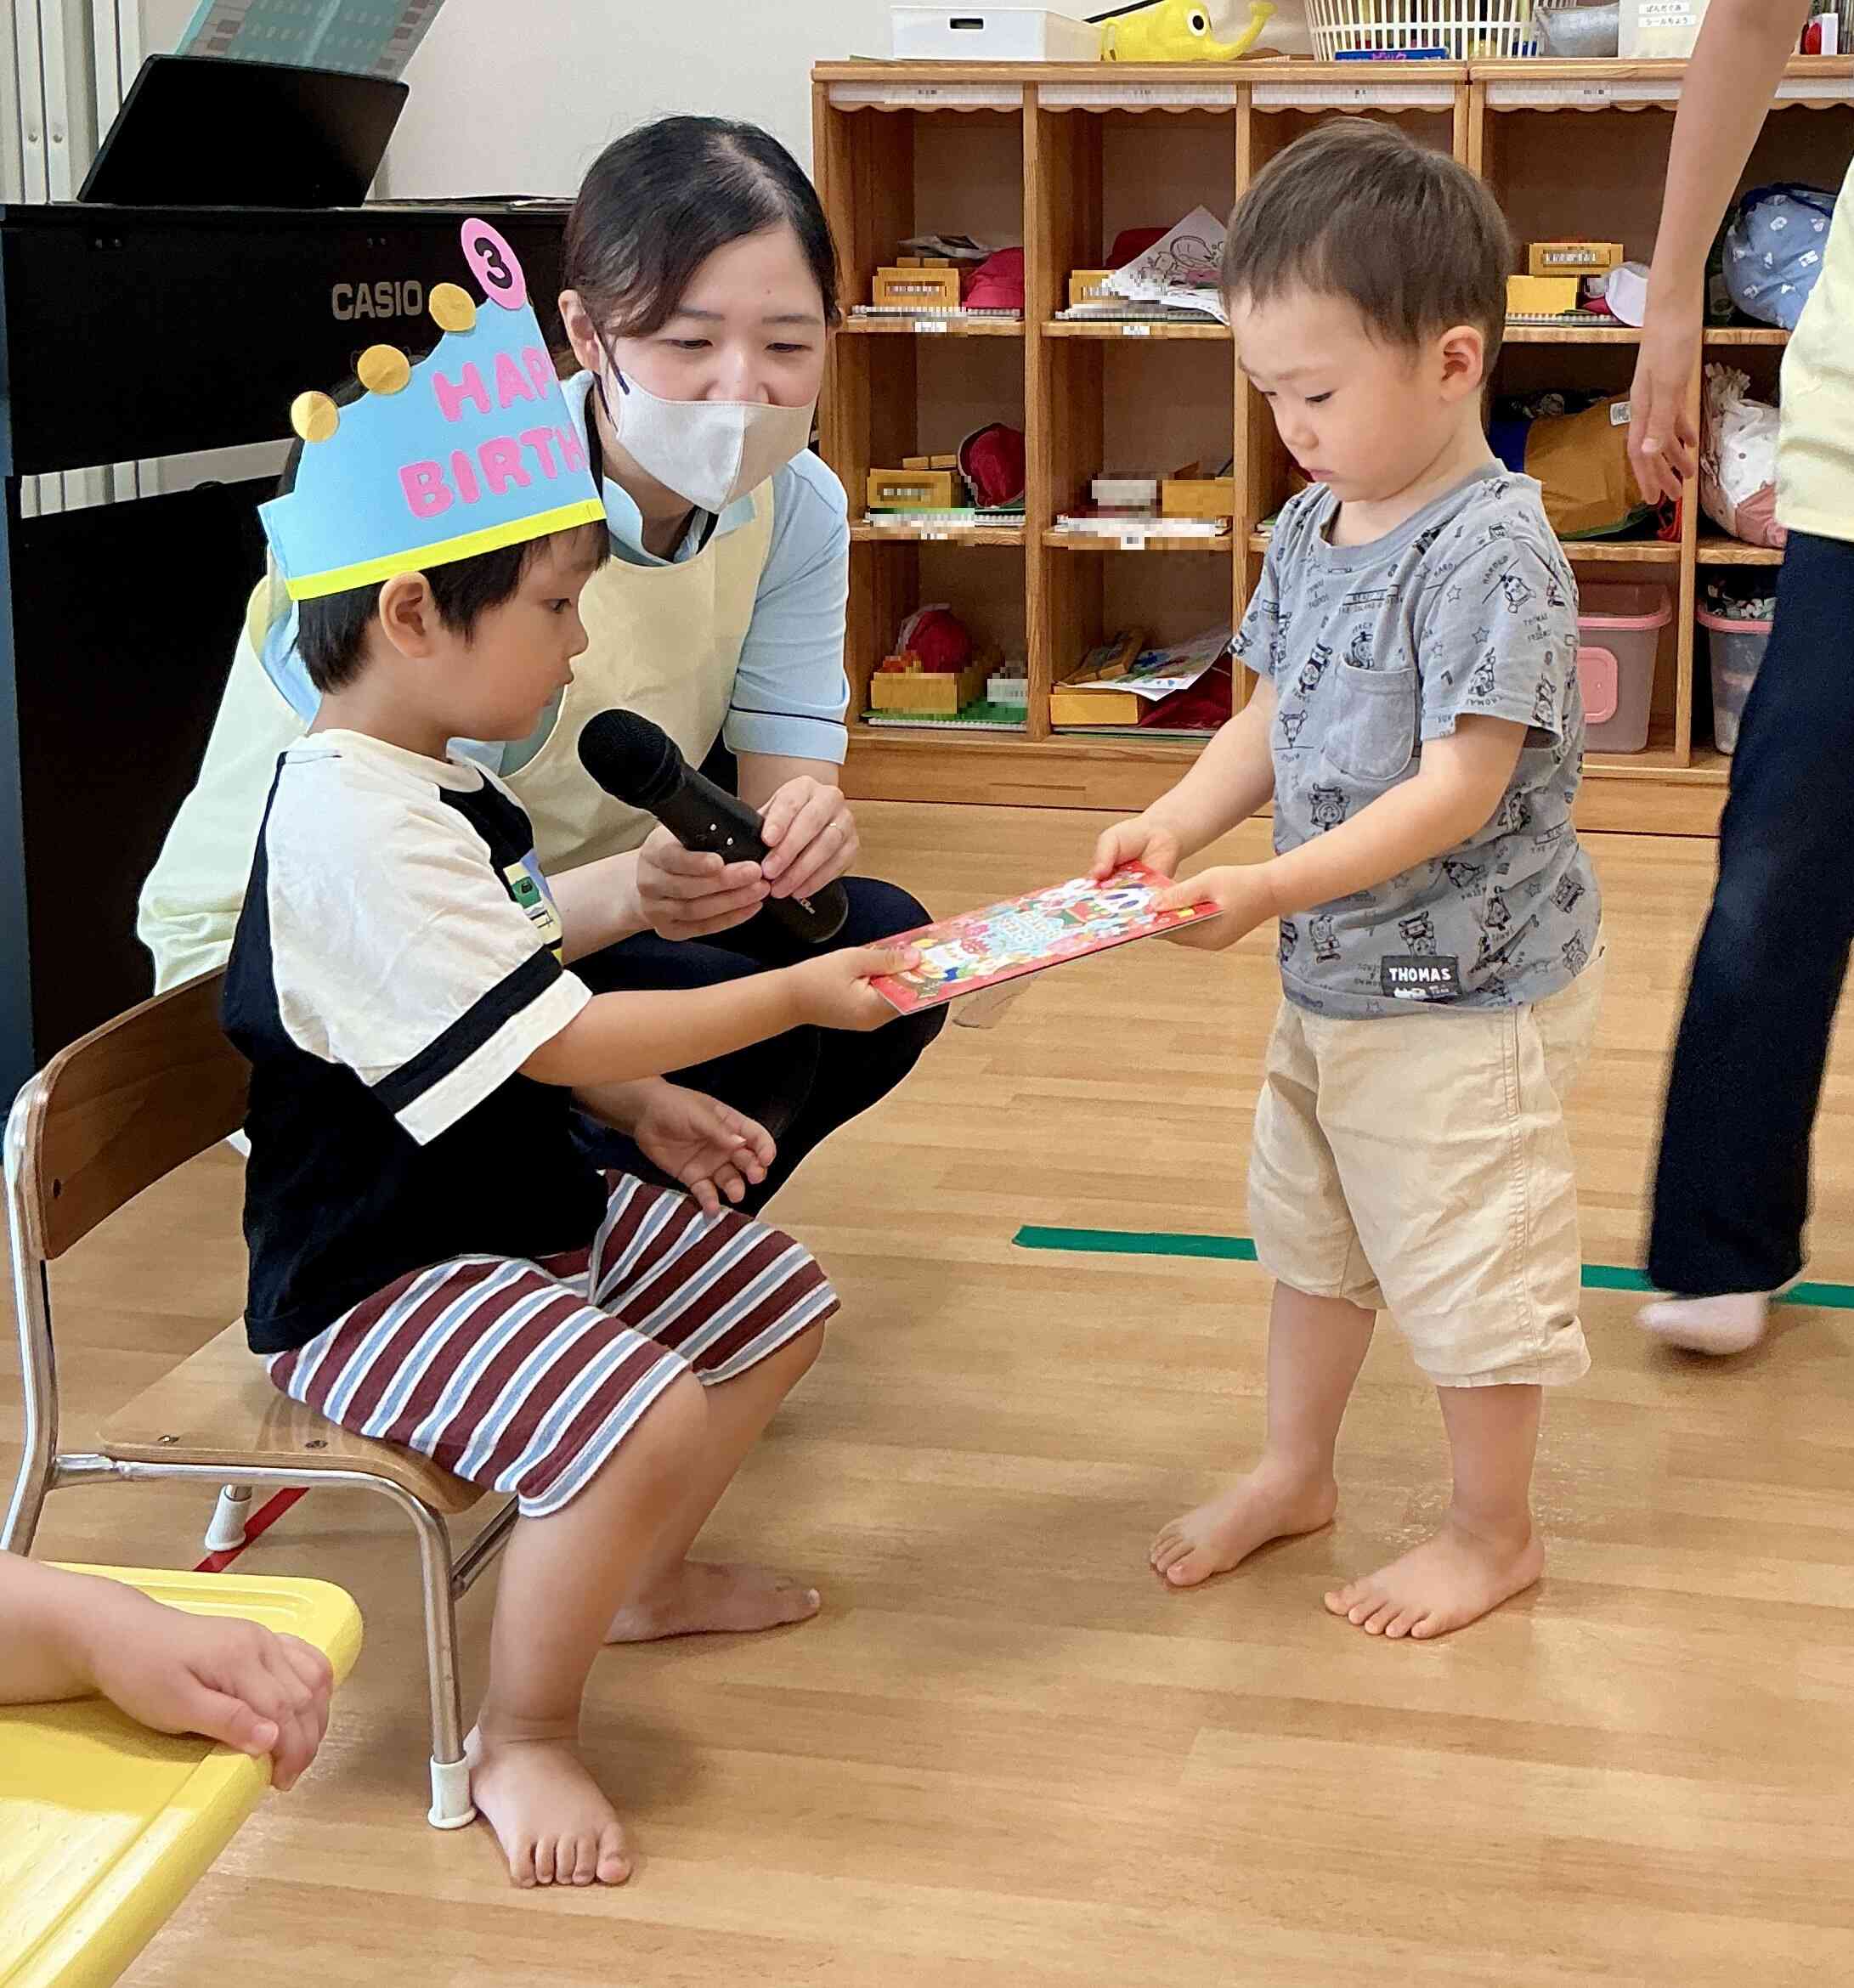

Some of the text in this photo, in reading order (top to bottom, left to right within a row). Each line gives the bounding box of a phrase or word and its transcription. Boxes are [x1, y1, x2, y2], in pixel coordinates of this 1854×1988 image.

[474, 236, 513, 290] 3
[331, 280, 423, 320] CASIO
[398, 424, 590, 519] BIRTH
[1388, 967, 1452, 982] THOMAS
